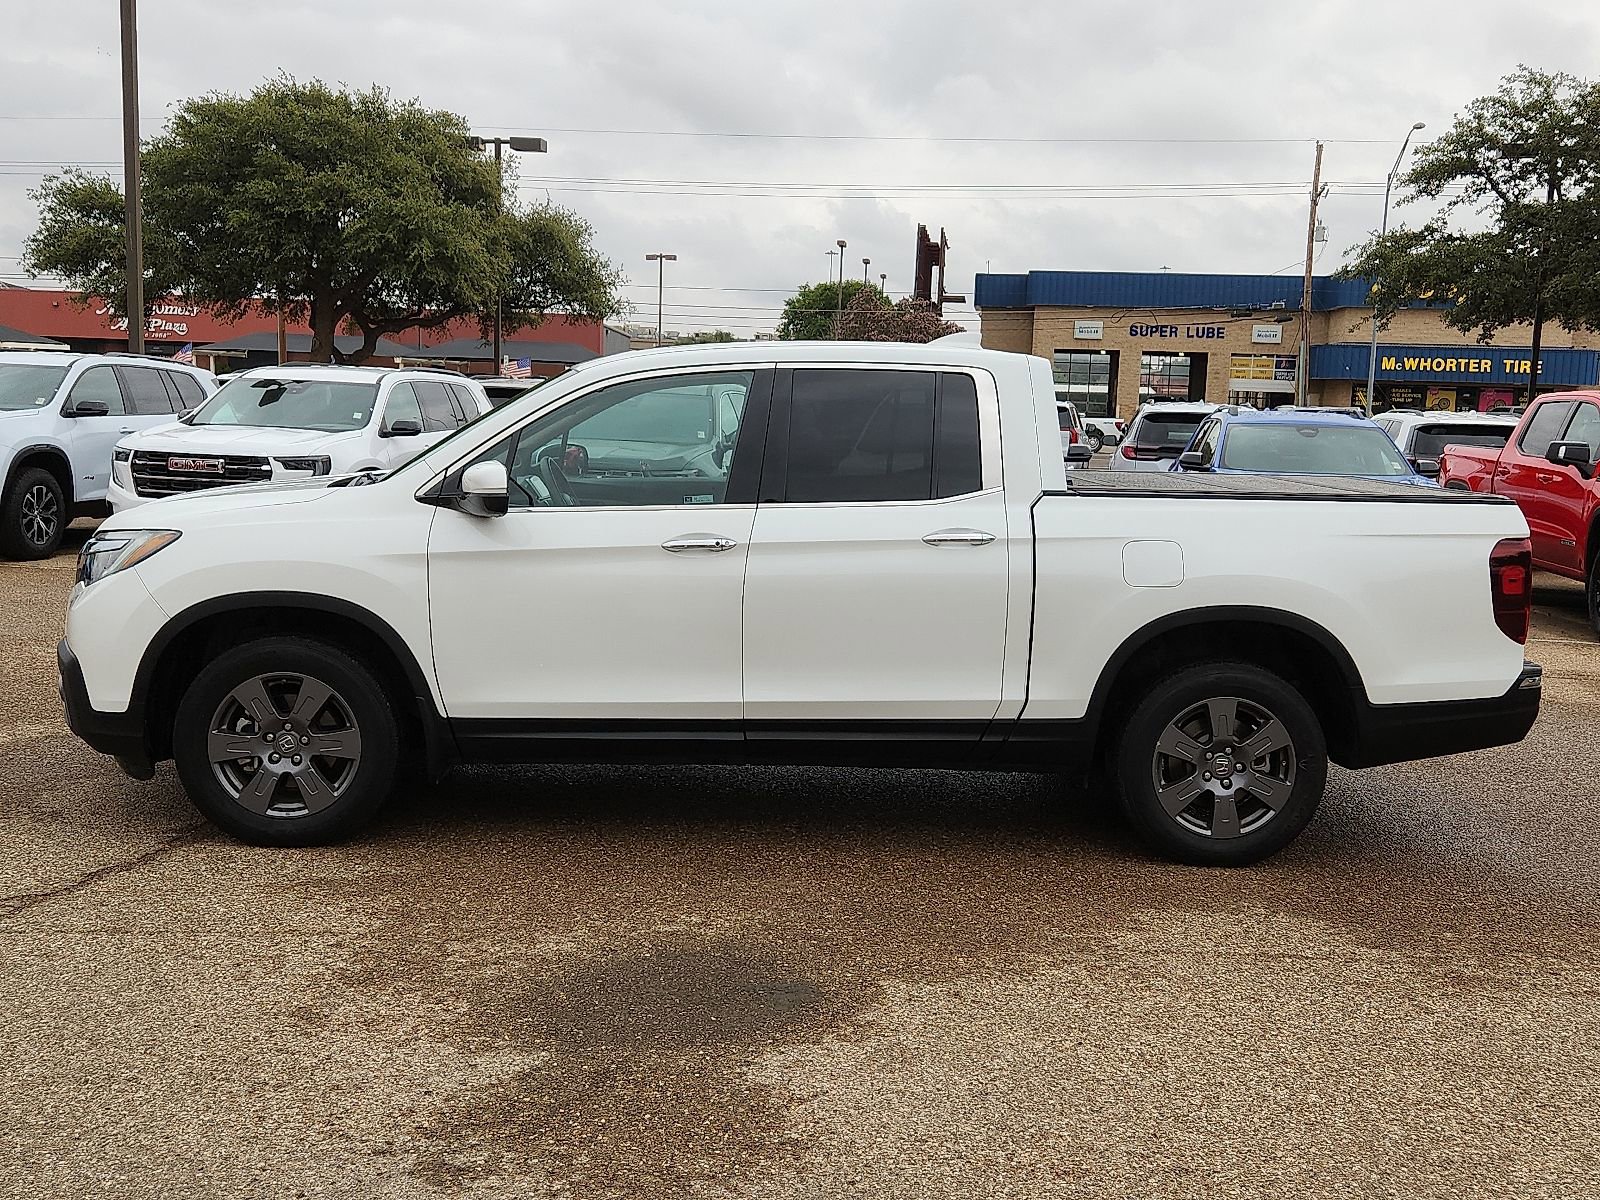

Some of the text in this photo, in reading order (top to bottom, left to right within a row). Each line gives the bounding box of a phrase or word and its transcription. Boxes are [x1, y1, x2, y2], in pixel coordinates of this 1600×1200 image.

[148, 318, 189, 336] Plaza
[1130, 324, 1226, 339] SUPER LUBE
[1381, 356, 1543, 374] McWHORTER TIRE
[168, 458, 219, 472] GMC
